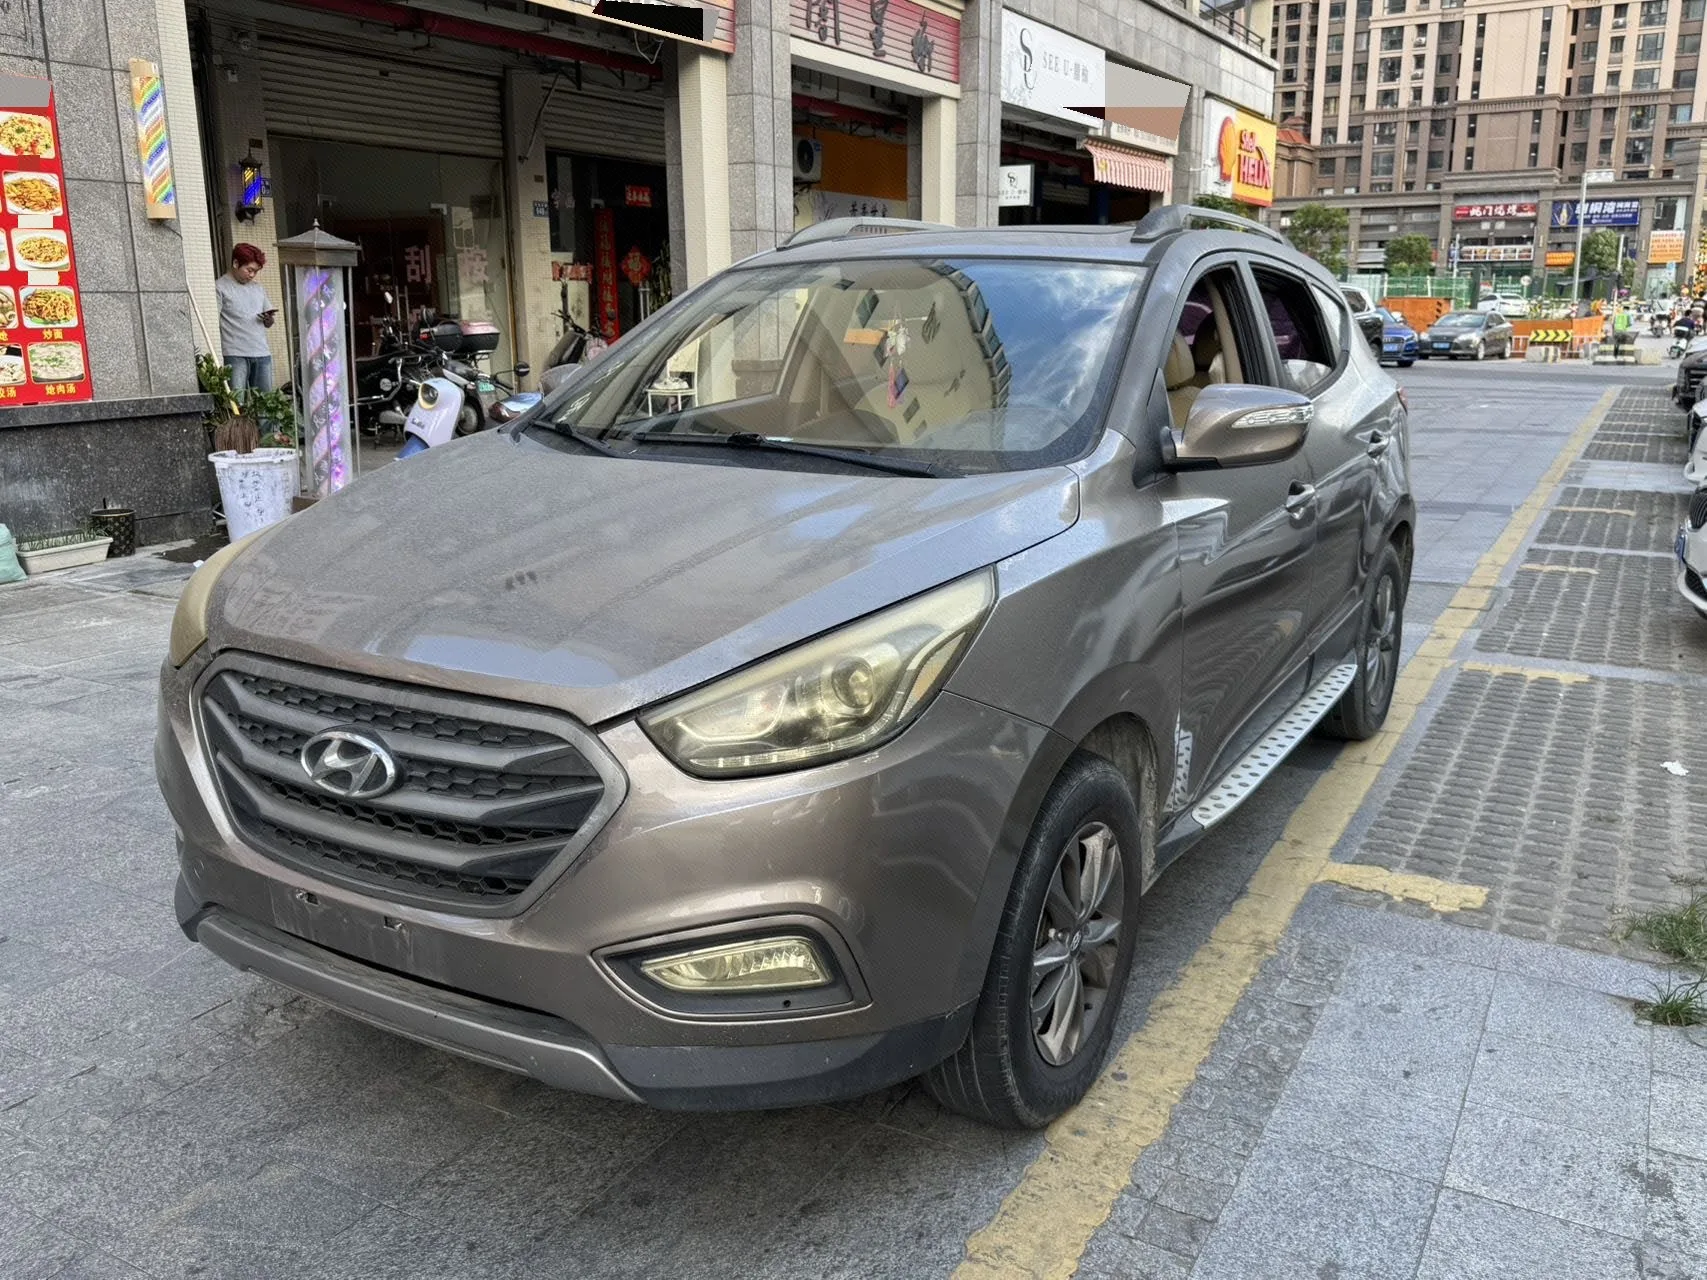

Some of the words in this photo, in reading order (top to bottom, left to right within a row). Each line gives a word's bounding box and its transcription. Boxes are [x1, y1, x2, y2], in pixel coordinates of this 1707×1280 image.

[1042, 51, 1059, 73] SEE
[1237, 147, 1272, 190] HELIX
[404, 244, 432, 284] 刮
[42, 329, 63, 340] 炒面
